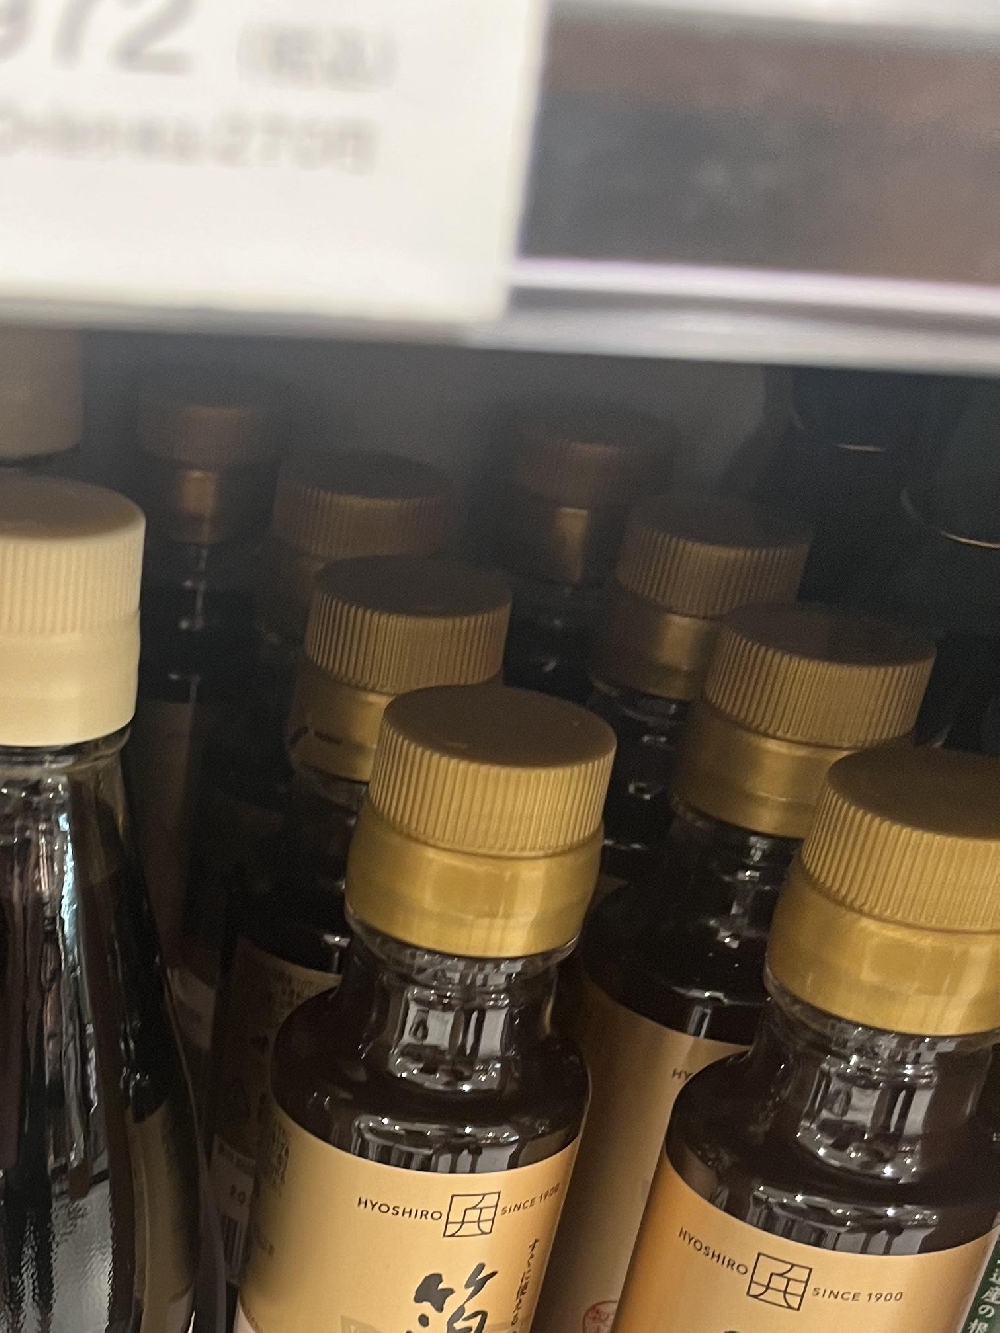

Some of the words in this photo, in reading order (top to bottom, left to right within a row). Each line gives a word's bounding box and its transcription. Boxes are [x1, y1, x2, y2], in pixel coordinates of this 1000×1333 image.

[356, 1196, 443, 1221] HYOSHIRO
[501, 1197, 537, 1216] SINCE
[677, 1225, 748, 1276] HYOSHIRO
[811, 1286, 861, 1303] SINCE
[866, 1290, 904, 1304] 1900
